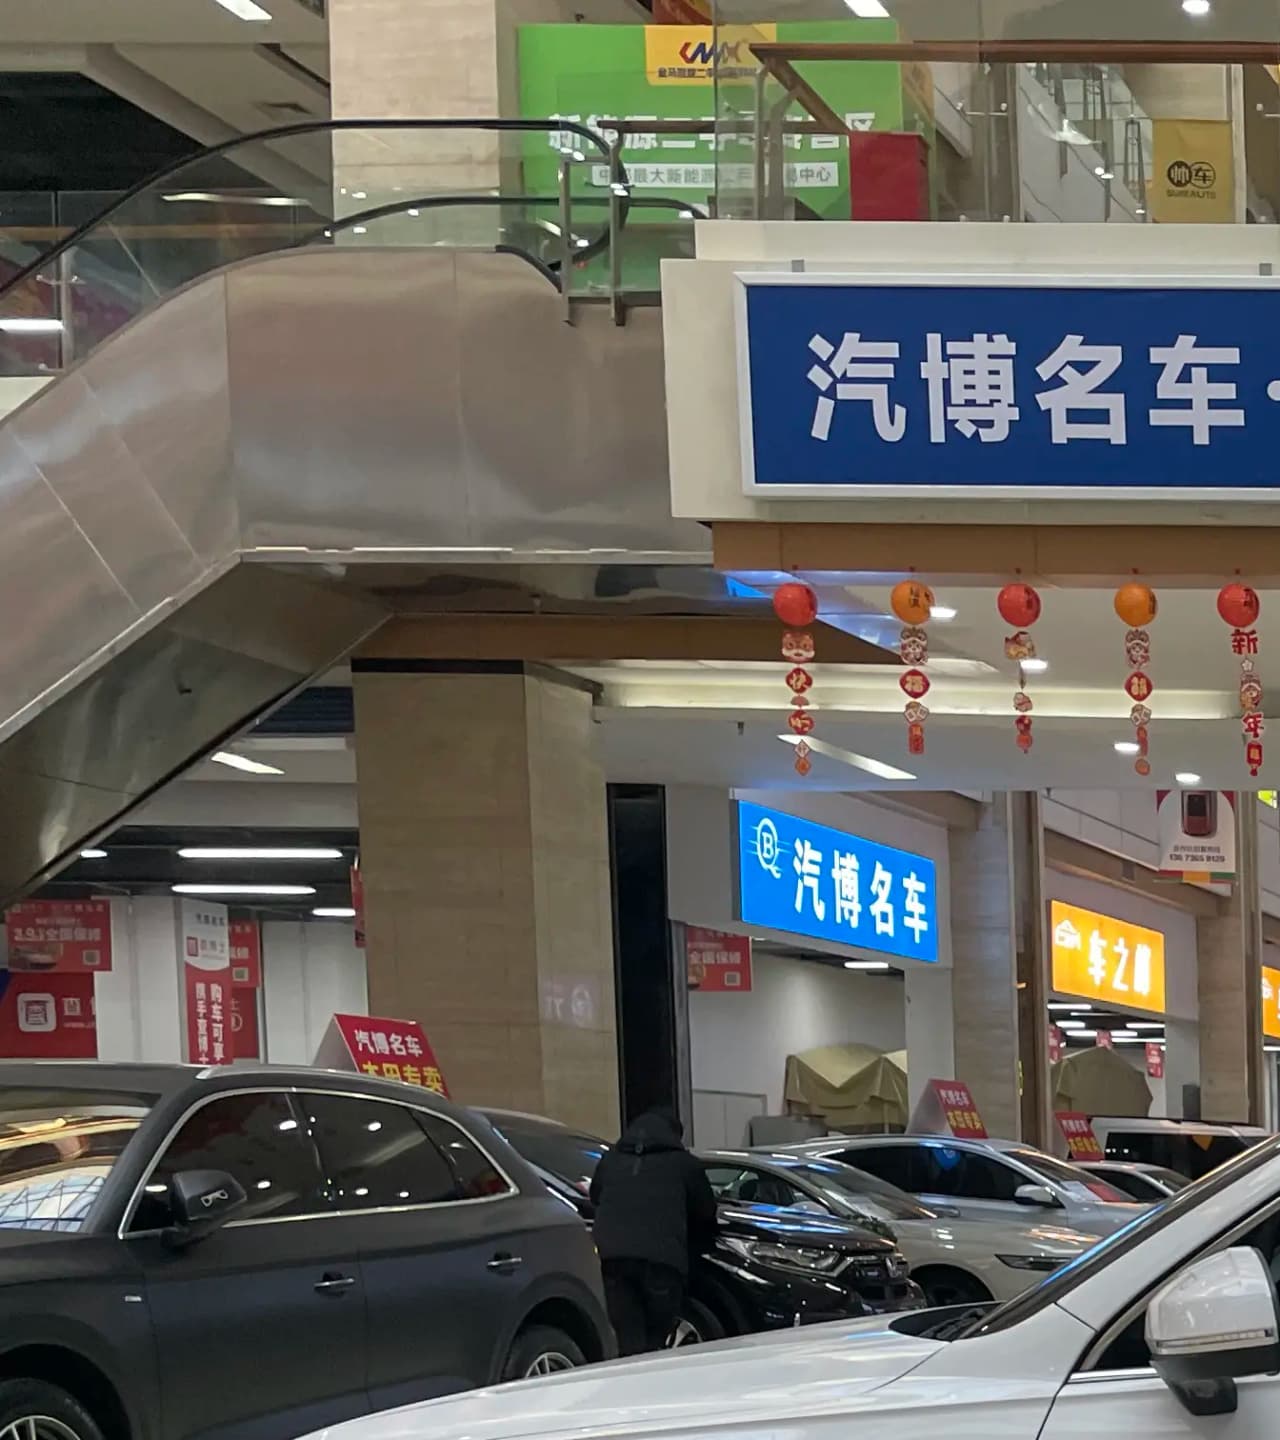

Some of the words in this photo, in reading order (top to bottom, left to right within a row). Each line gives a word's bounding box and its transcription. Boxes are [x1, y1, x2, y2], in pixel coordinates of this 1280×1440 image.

[792, 837, 928, 944] 汽博名车
[354, 1029, 423, 1057] 汽博名车
